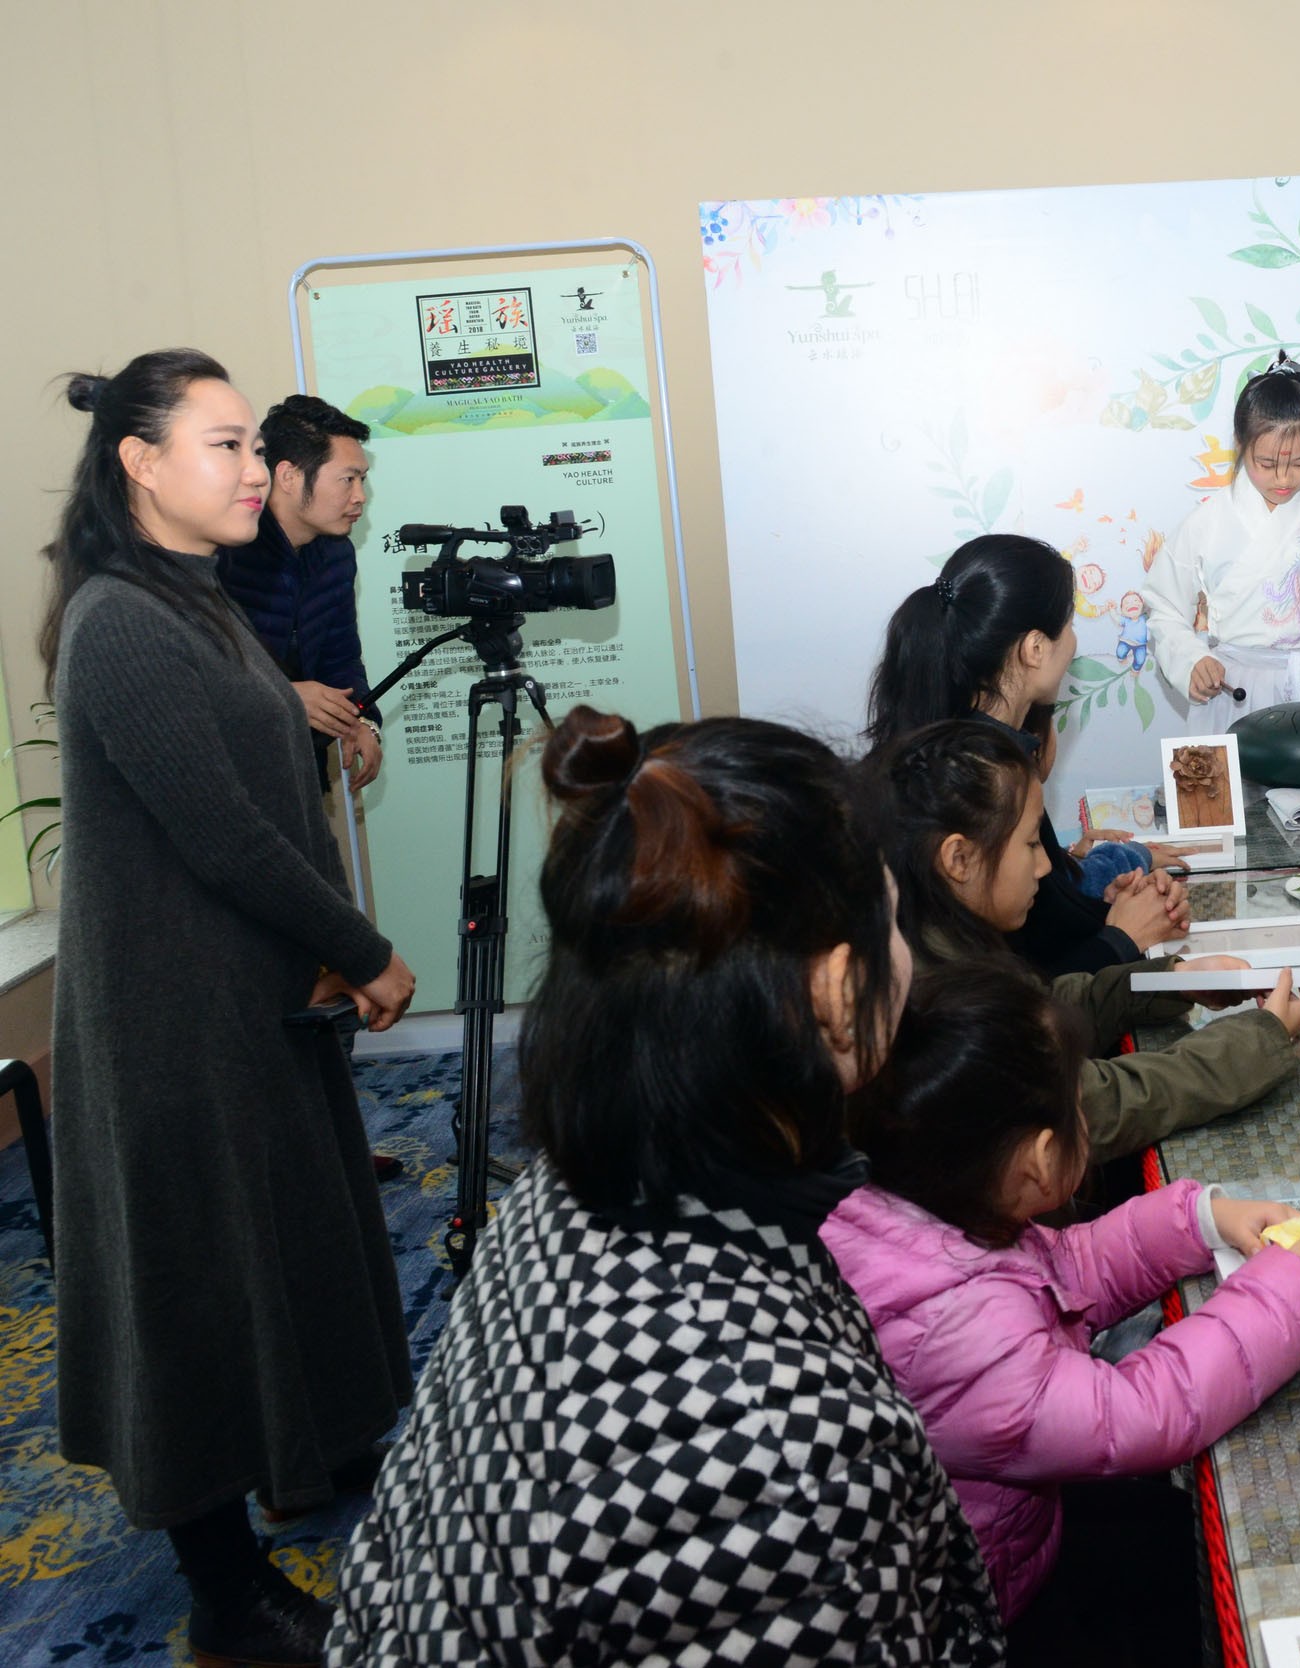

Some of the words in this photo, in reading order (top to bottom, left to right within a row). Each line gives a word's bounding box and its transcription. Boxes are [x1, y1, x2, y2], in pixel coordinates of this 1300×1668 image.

[426, 300, 458, 335] 瑶
[491, 296, 529, 330] 族
[472, 359, 511, 367] HEALTH
[434, 368, 480, 377] CULTURE
[482, 364, 528, 373] GALLERY
[563, 471, 579, 480] YAO
[581, 469, 613, 478] HEALTH
[576, 477, 614, 487] CULTURE
